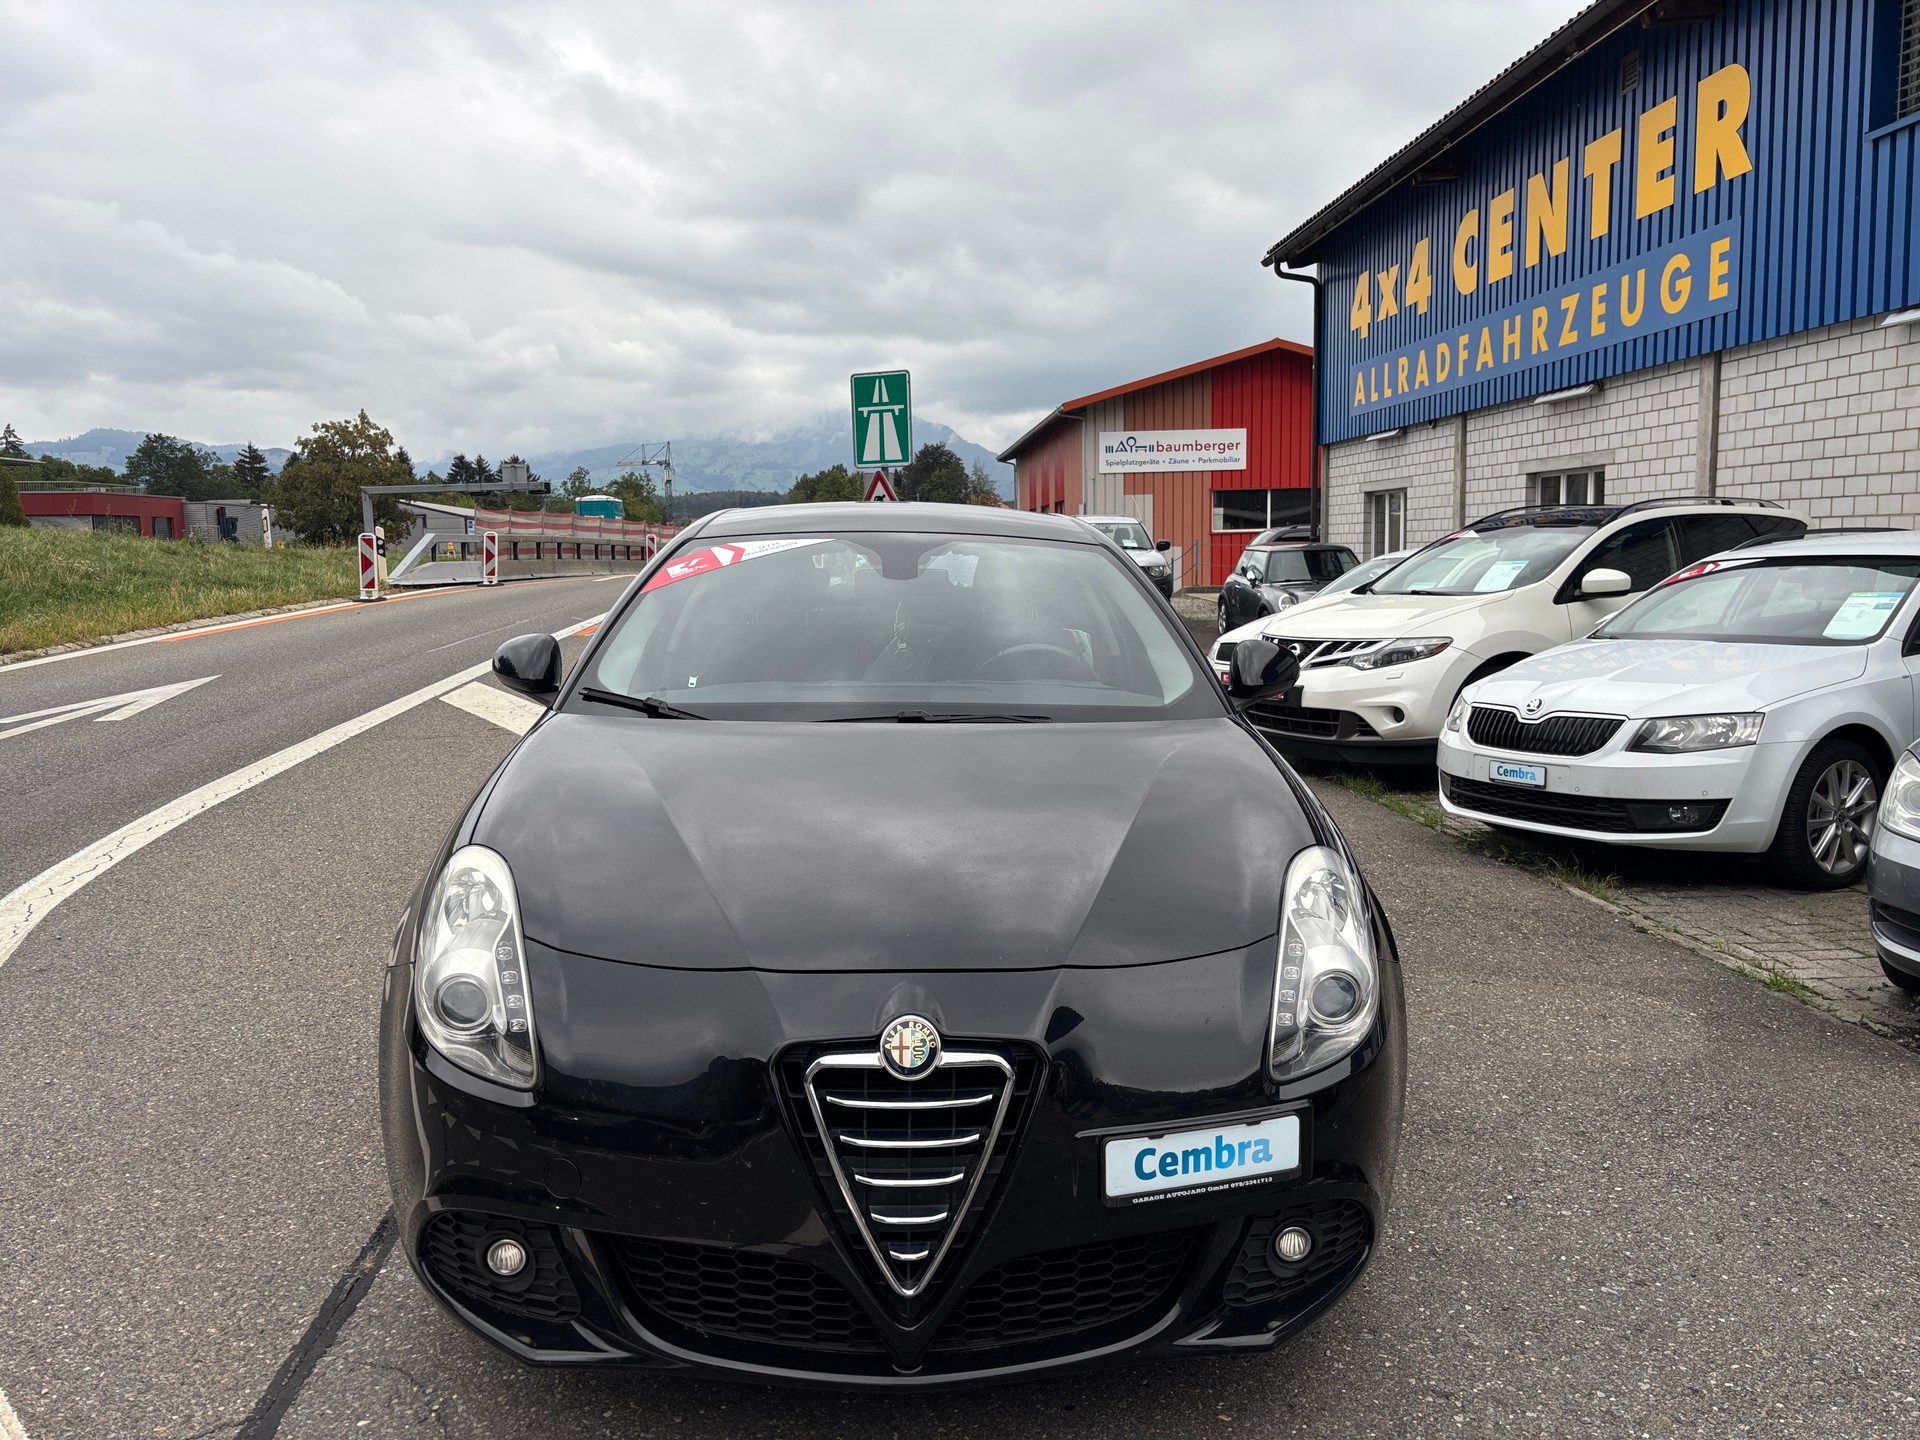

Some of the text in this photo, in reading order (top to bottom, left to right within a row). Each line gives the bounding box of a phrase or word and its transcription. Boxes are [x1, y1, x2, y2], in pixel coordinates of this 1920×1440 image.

[1350, 63, 1753, 339] 4x4 CENTER
[1353, 237, 1731, 407] ALLRADFAHRZEUGE
[1156, 439, 1241, 454] baumberger
[1105, 456, 1241, 468] Spielplatzgeräte Zäune Parkmobiliar
[1496, 765, 1537, 781] Cembra
[884, 1021, 936, 1050] ALFA ROMEO
[1134, 1135, 1273, 1181] Cembra
[1132, 1194, 1166, 1204] GARAGE
[1207, 1183, 1230, 1192] GmbH
